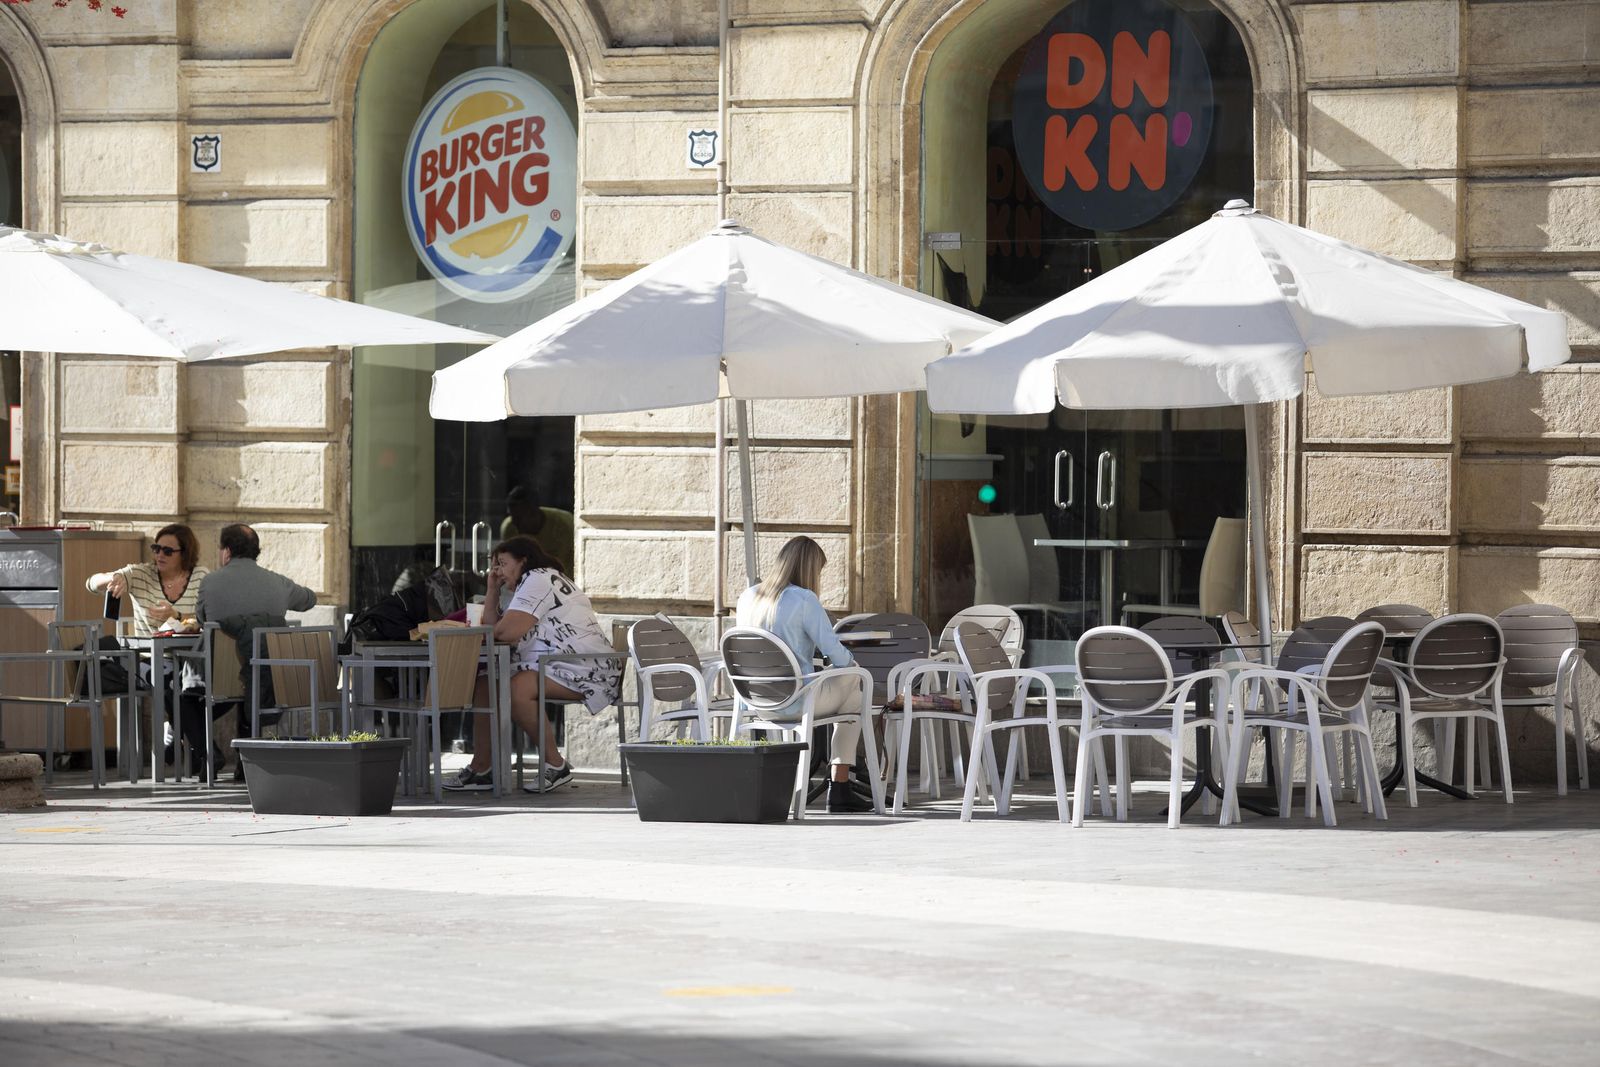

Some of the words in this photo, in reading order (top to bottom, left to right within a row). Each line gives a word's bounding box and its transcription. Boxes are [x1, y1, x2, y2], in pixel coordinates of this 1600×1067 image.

[1046, 29, 1171, 109] DN
[420, 115, 545, 192] BURGER
[424, 152, 550, 247] KING
[0, 559, 39, 570] RACIAS
